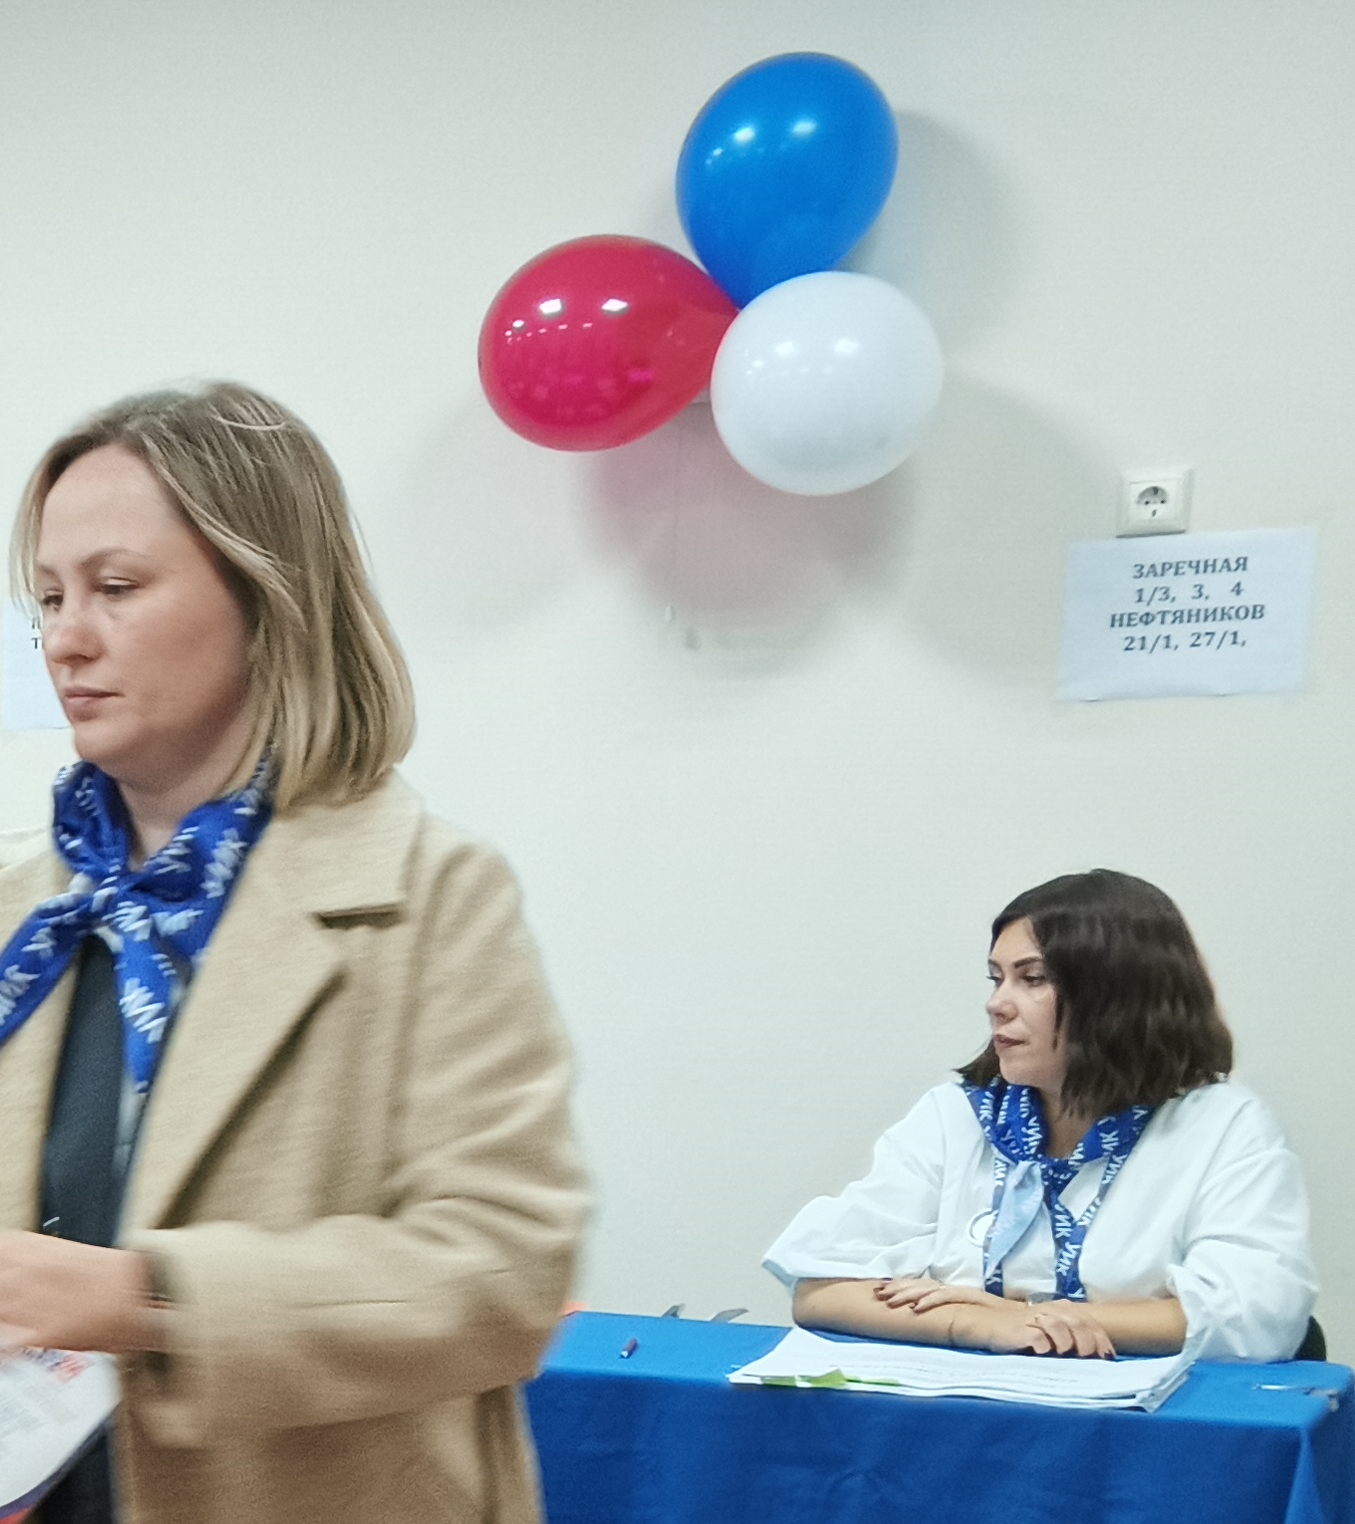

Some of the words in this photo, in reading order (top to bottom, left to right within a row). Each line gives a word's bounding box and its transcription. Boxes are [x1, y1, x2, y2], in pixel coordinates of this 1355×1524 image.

[1132, 555, 1249, 580] ЗАРЕЧНАЯ
[1134, 585, 1177, 606] 1/3,
[1191, 583, 1211, 601] 3,
[1230, 581, 1244, 597] 4
[1109, 603, 1266, 629] НЕФТЯНИКОВ
[1122, 634, 1180, 654] 21/1,
[1189, 631, 1247, 651] 27/1,
[1056, 1241, 1083, 1277] УИК
